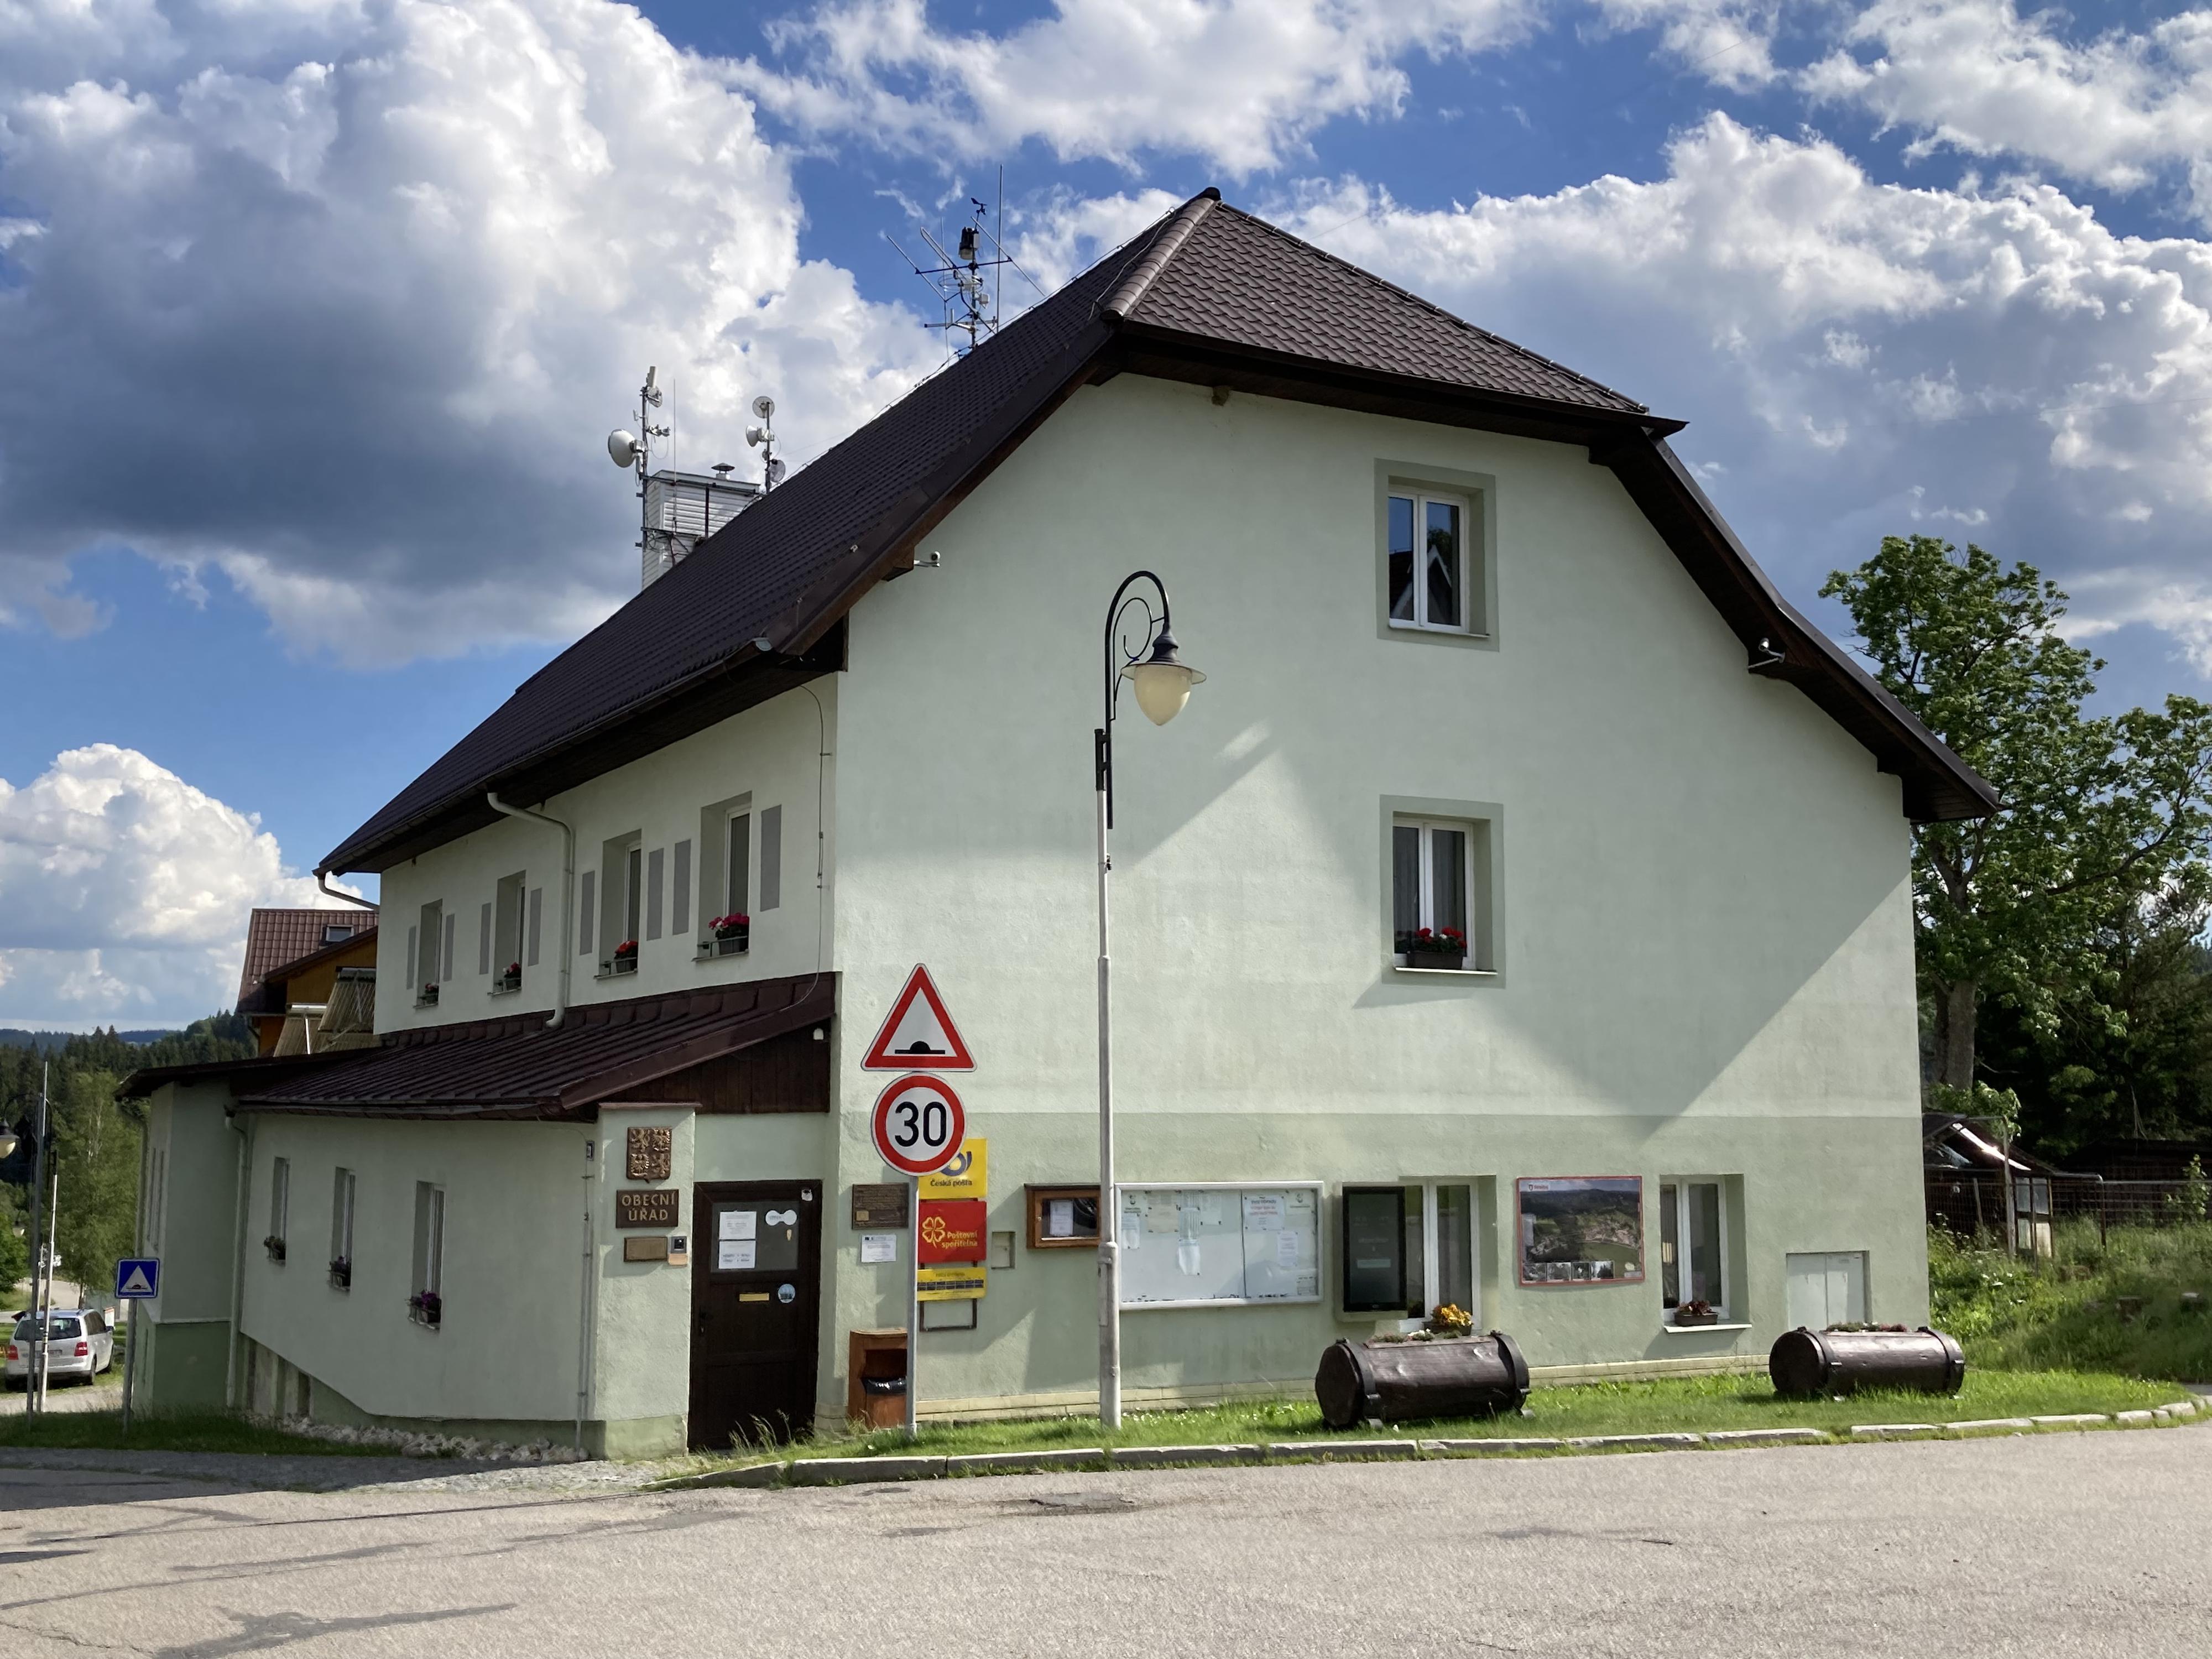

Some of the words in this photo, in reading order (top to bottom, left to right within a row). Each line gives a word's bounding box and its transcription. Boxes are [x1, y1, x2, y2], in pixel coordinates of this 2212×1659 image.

[895, 1101, 946, 1146] 30
[622, 1191, 675, 1206] OBECNÍ
[628, 1207, 668, 1221] ÚŘAD
[947, 1230, 978, 1239] Poštovní
[941, 1240, 978, 1249] spořitelna
